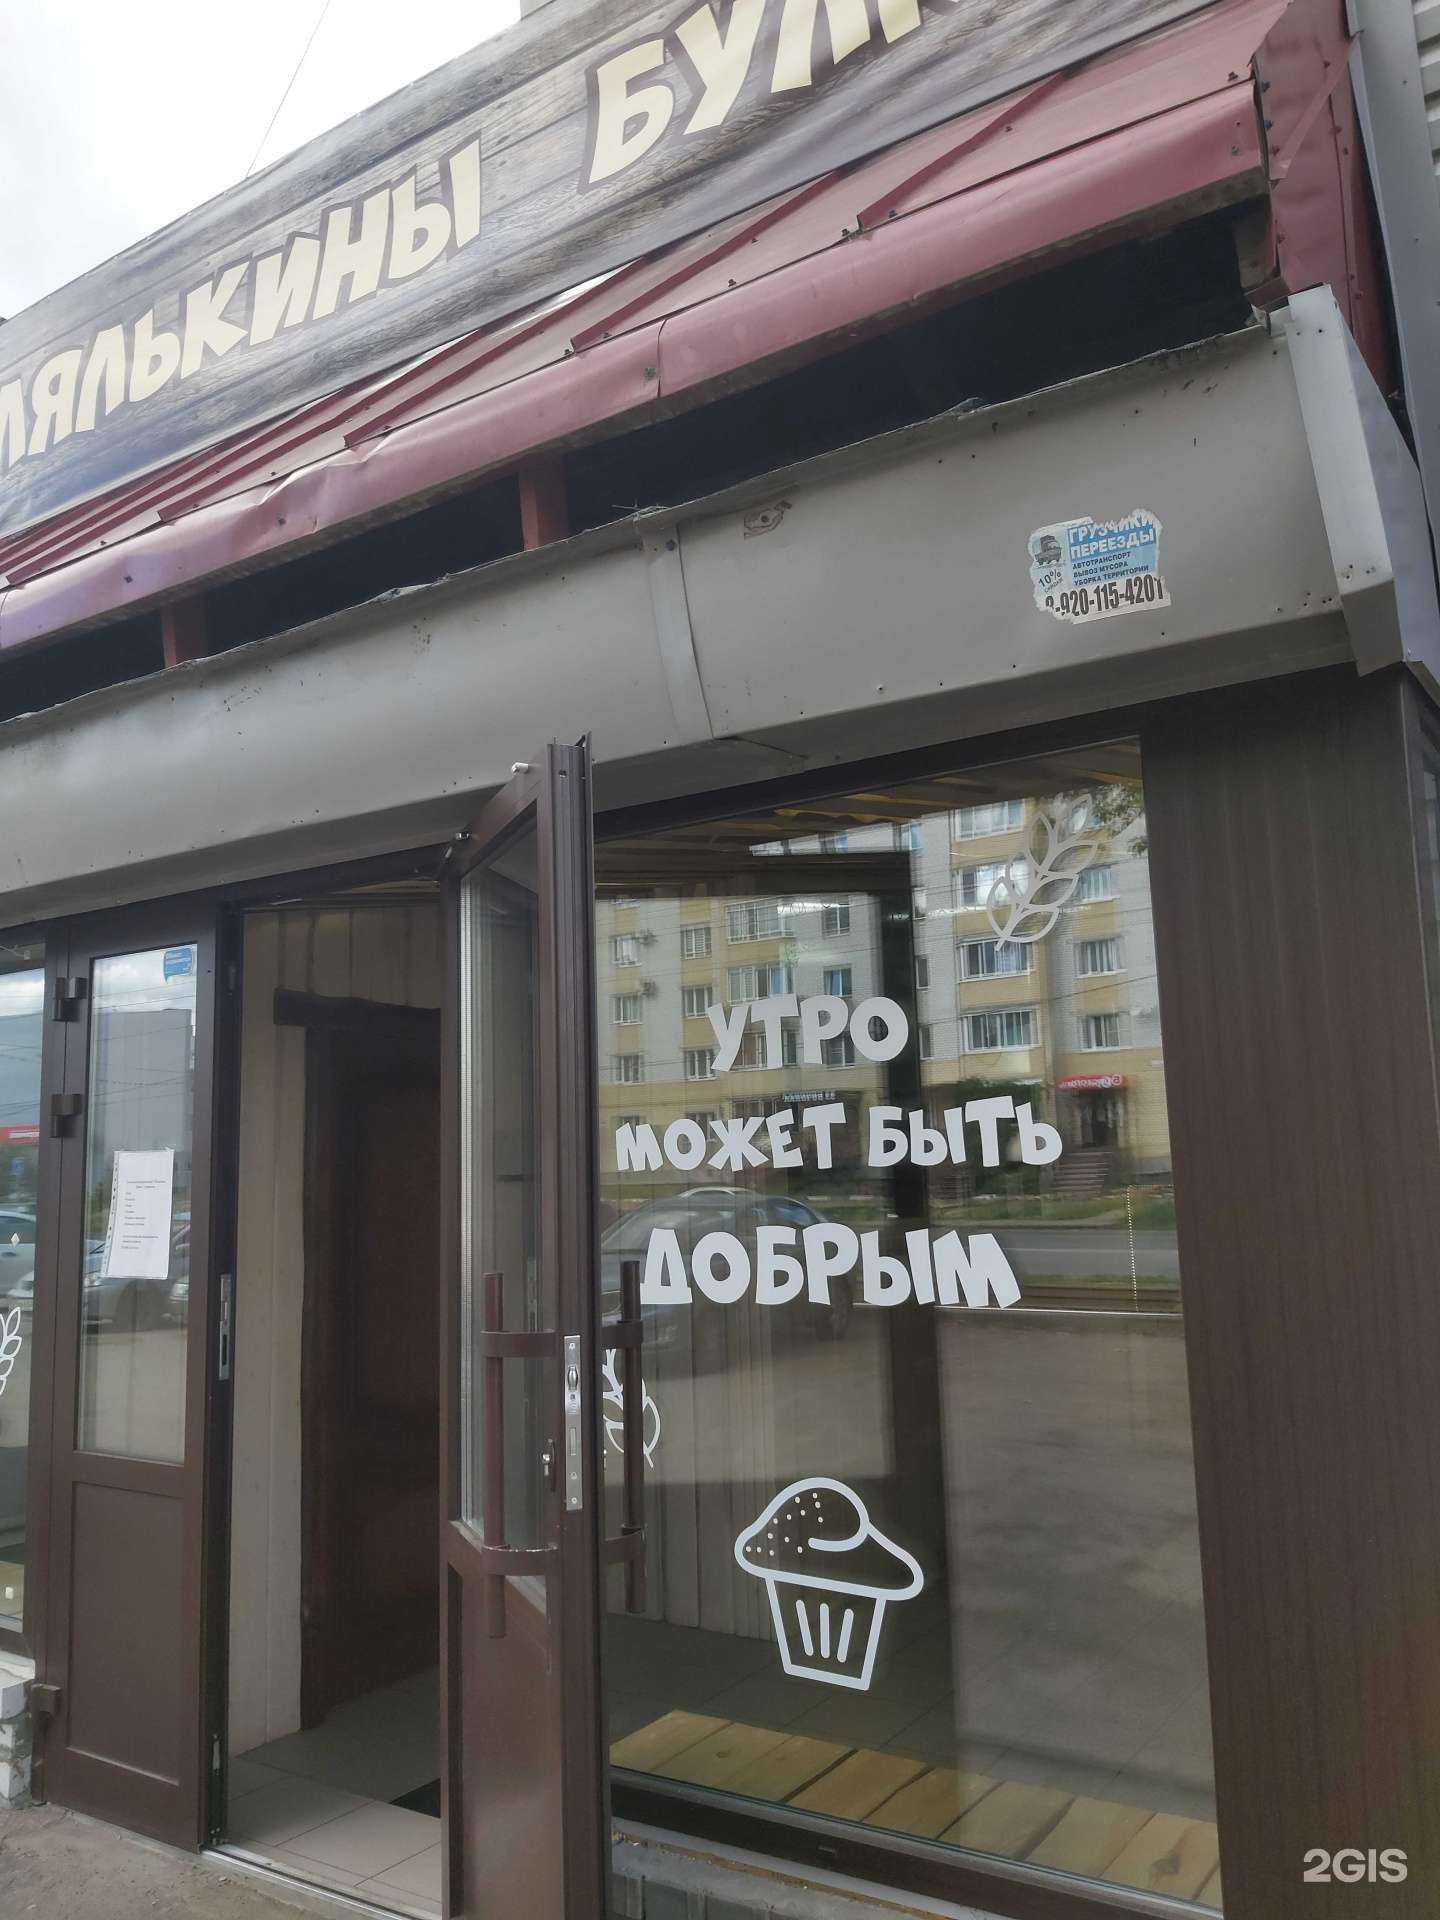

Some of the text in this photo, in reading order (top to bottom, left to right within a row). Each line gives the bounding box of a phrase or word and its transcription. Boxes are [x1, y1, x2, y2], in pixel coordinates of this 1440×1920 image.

[588, 0, 959, 184] БУЛ
[1070, 528, 1154, 559] ПЕРЕЕЗДЫ
[1072, 551, 1131, 570] АВТОТРАНСПОРТ
[1073, 562, 1128, 578] ВЫВОЗ МУСОРА
[1074, 576, 1102, 586] УБОРКА
[1103, 565, 1149, 580] ТЕРРИТОРИИ
[1039, 569, 1062, 587] 10%
[706, 995, 910, 1072] УТРО
[615, 1095, 1063, 1172] МОЖЕТ БЫТЬ
[639, 1222, 1023, 1309] ДОБРЫМ
